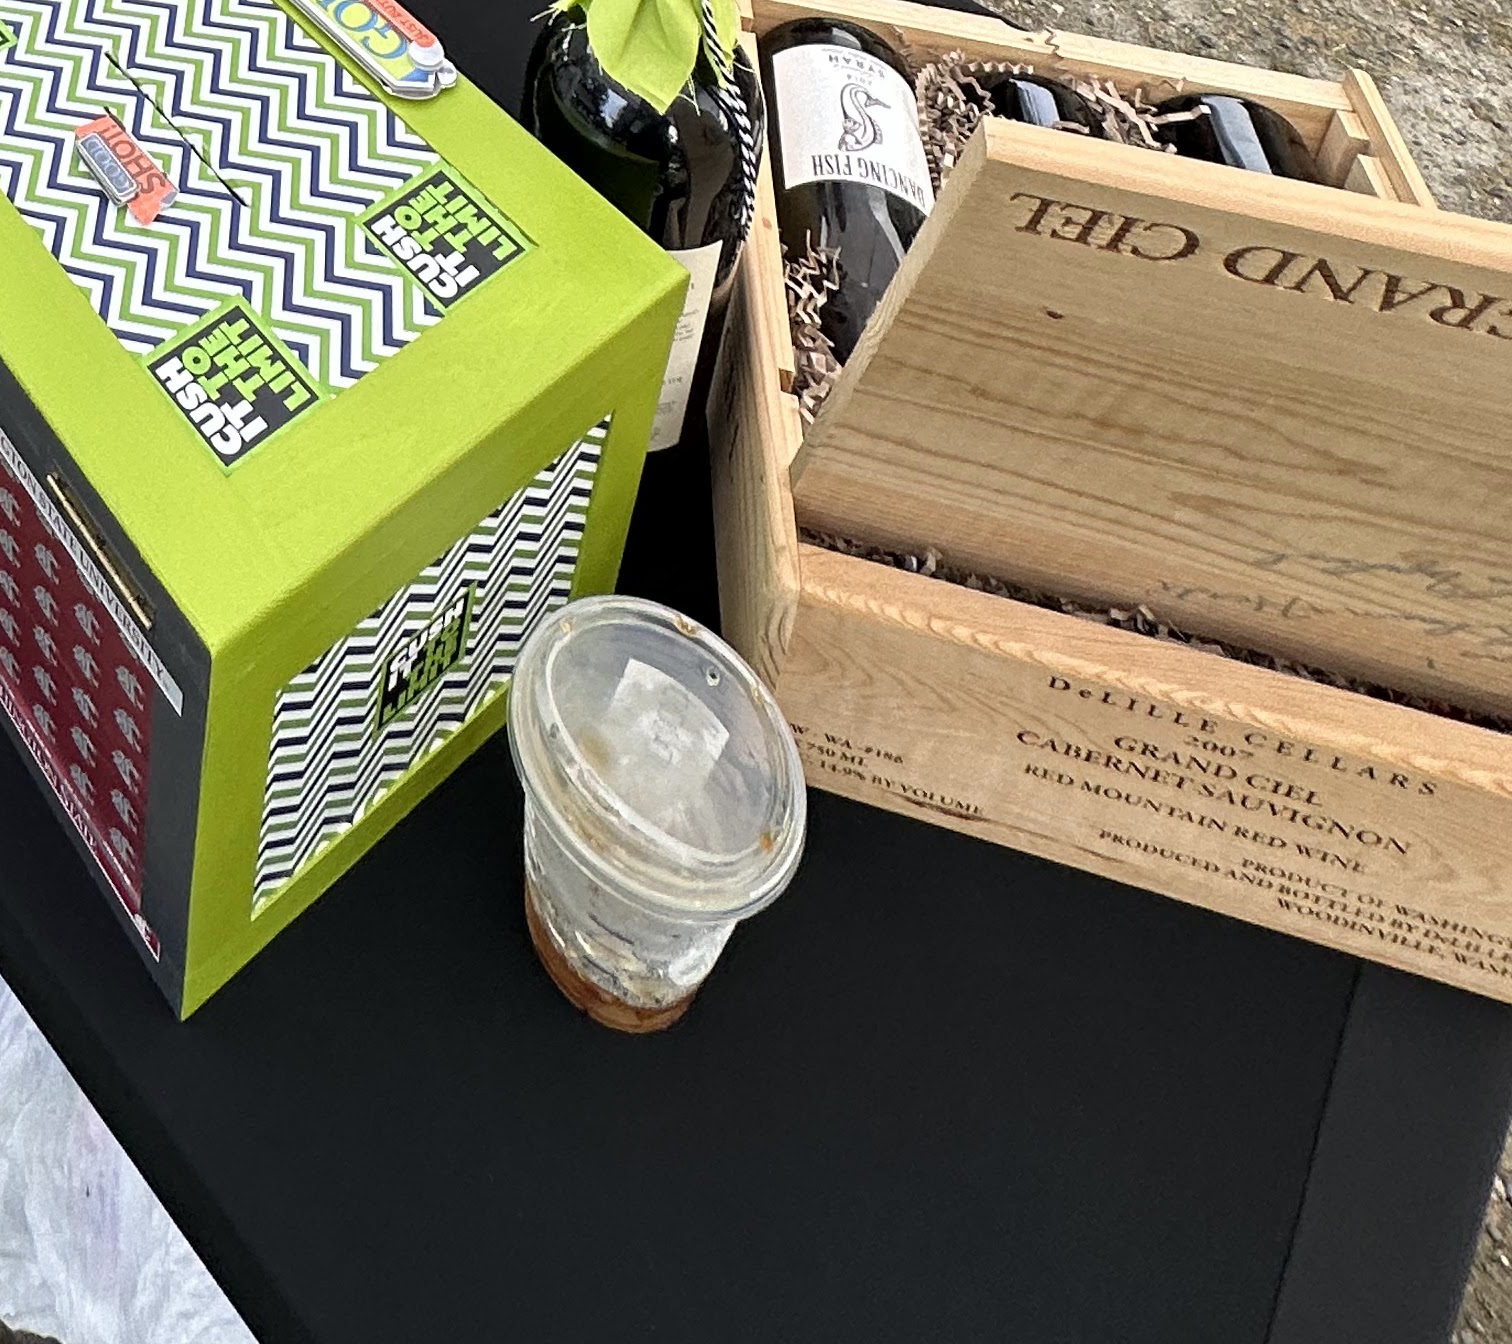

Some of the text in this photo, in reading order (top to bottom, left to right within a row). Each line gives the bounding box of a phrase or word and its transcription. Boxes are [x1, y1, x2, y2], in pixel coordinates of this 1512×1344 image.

[408, 190, 473, 253] THE
[425, 181, 518, 261] LIMIT
[811, 154, 926, 209] DANCING FISH
[371, 214, 458, 298] CUSH
[394, 205, 480, 287] IT TO
[1010, 192, 1201, 261] CIEL
[155, 356, 242, 455] CUSH
[182, 346, 270, 443] IT TO
[198, 327, 266, 402] THE
[219, 318, 311, 412] LIMIT
[39, 491, 76, 553] STATE
[78, 552, 165, 686] UNIVERSITY
[1049, 675, 1438, 797] DeLILLE CELLARS
[1114, 736, 1322, 807] GRAND CIEL
[1016, 730, 1411, 855] CABERNET SAUVIGNON
[1025, 763, 1369, 874] RED MOUNTAIN RED WINE
[1099, 829, 1221, 874] PRODUCED
[1224, 869, 1274, 889] AND
